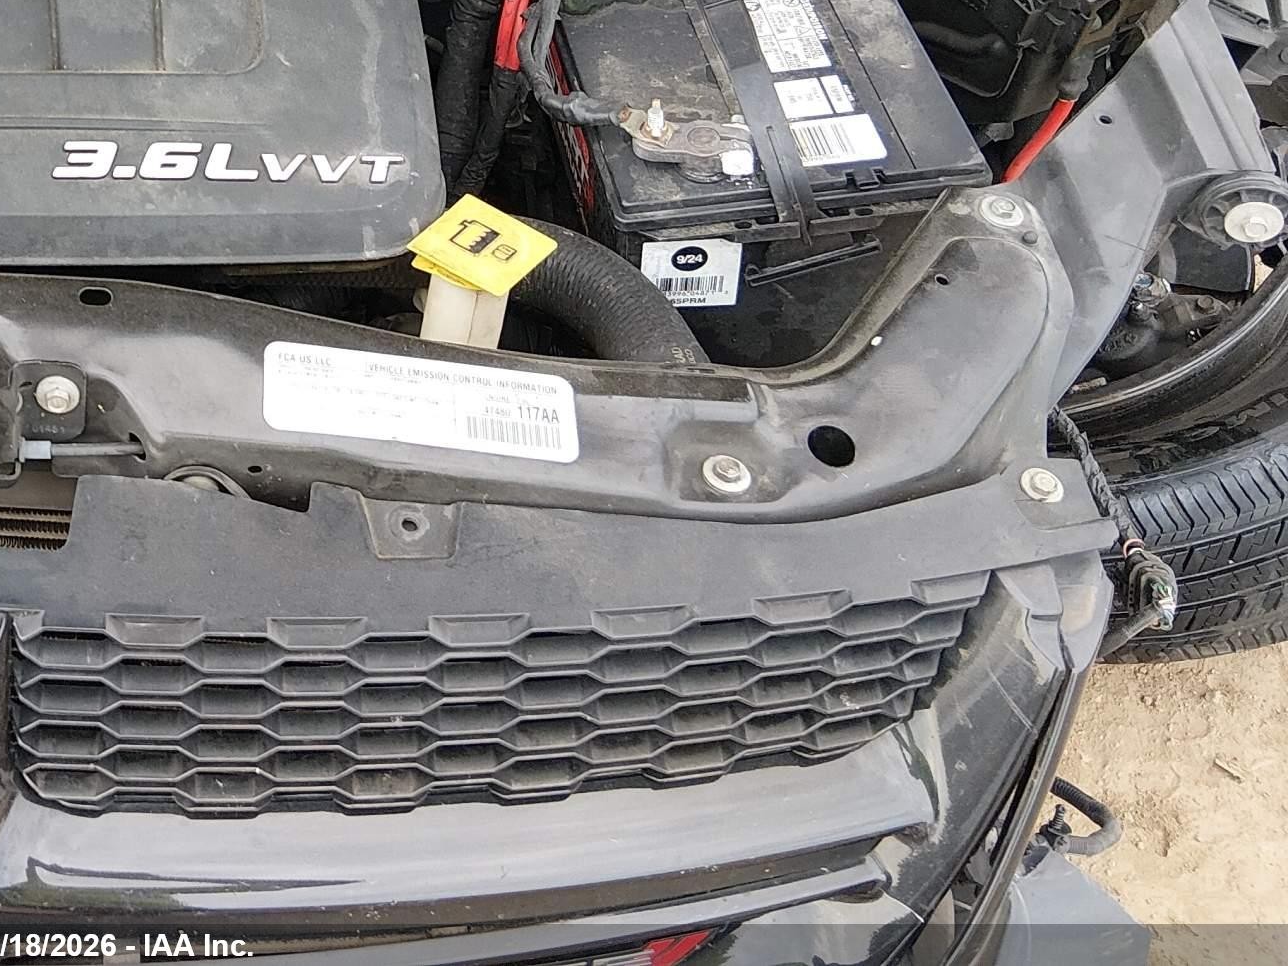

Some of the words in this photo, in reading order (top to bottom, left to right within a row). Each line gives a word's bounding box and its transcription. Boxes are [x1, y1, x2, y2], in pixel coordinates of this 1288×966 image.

[676, 254, 703, 264] 9/24
[368, 362, 405, 377] VEHICLE
[407, 367, 450, 382] EMISSION
[453, 374, 493, 388] CONTROL
[496, 378, 558, 396] INFORMATION
[517, 404, 561, 424] 117AA
